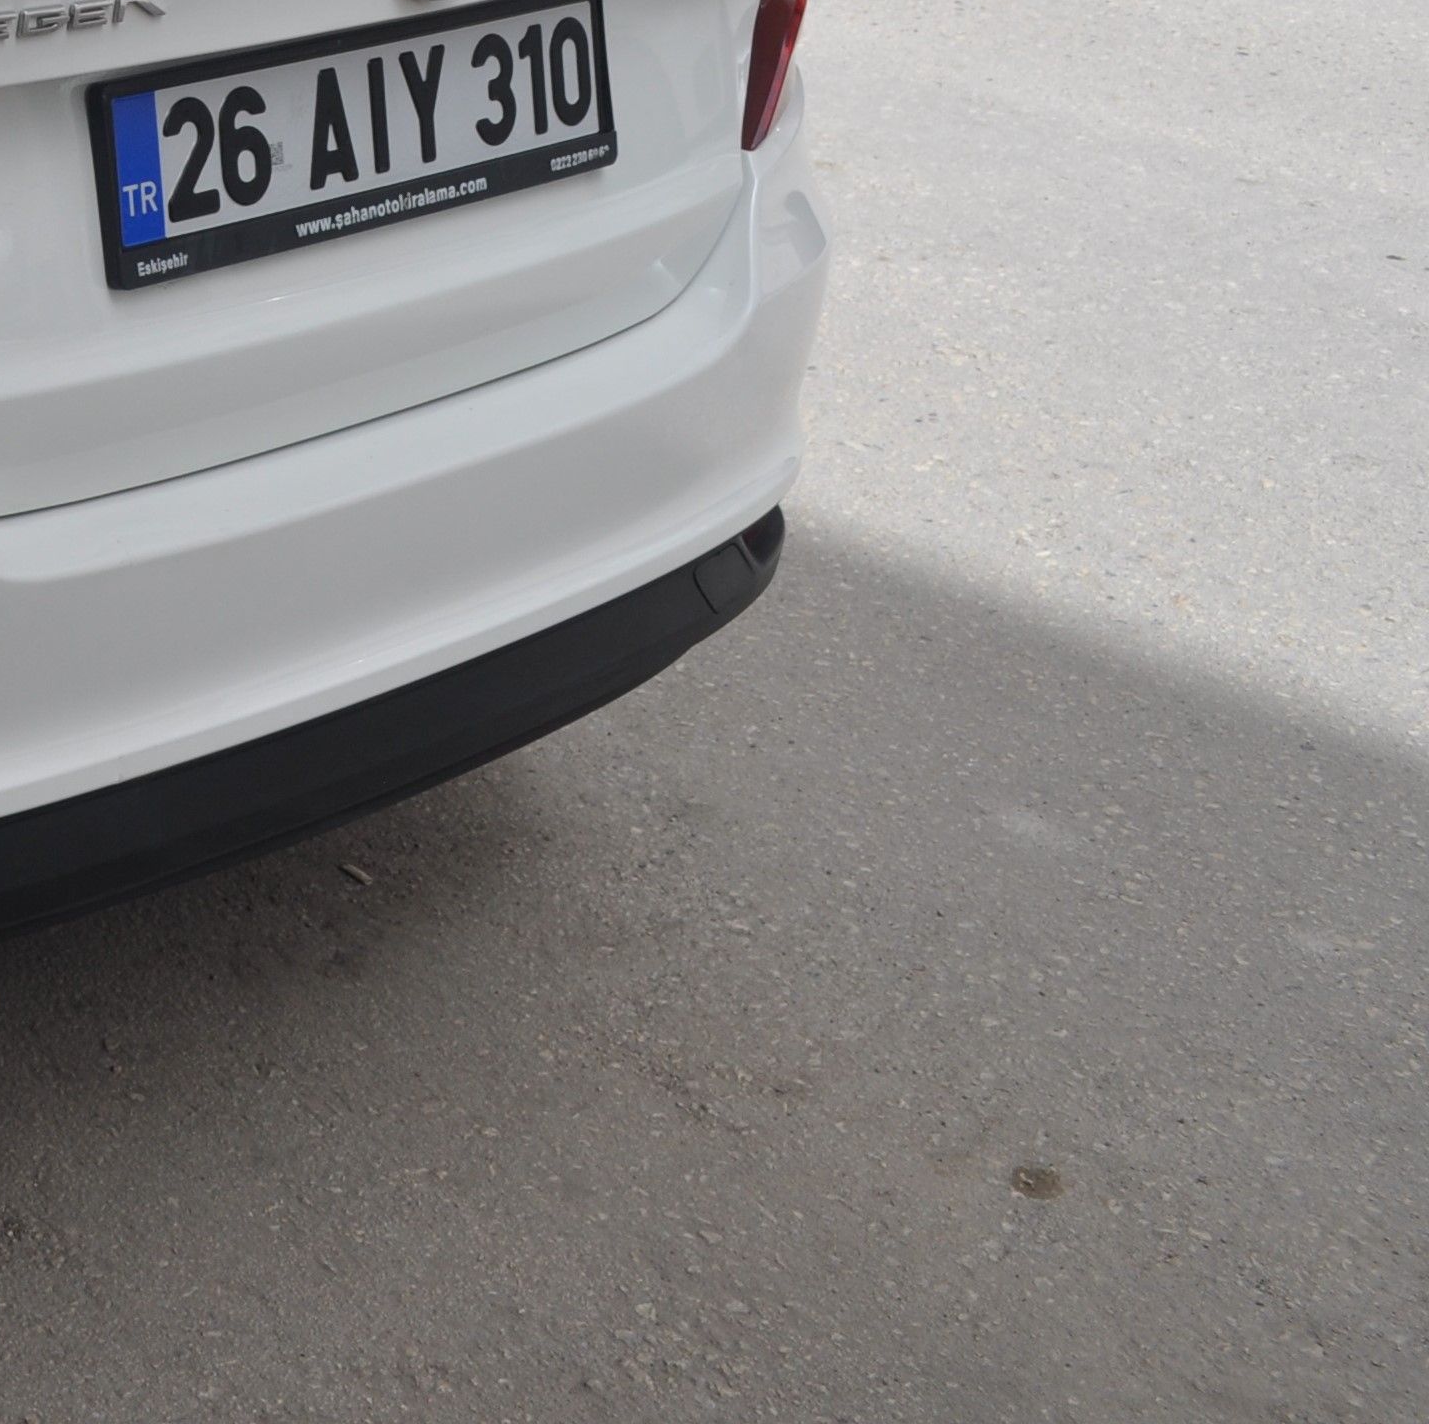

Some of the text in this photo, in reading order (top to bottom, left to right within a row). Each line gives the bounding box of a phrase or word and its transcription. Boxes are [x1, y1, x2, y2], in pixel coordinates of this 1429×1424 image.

[161, 16, 593, 224] 26 AIY 310
[122, 181, 159, 218] TR
[137, 251, 189, 277] Eskişehir
